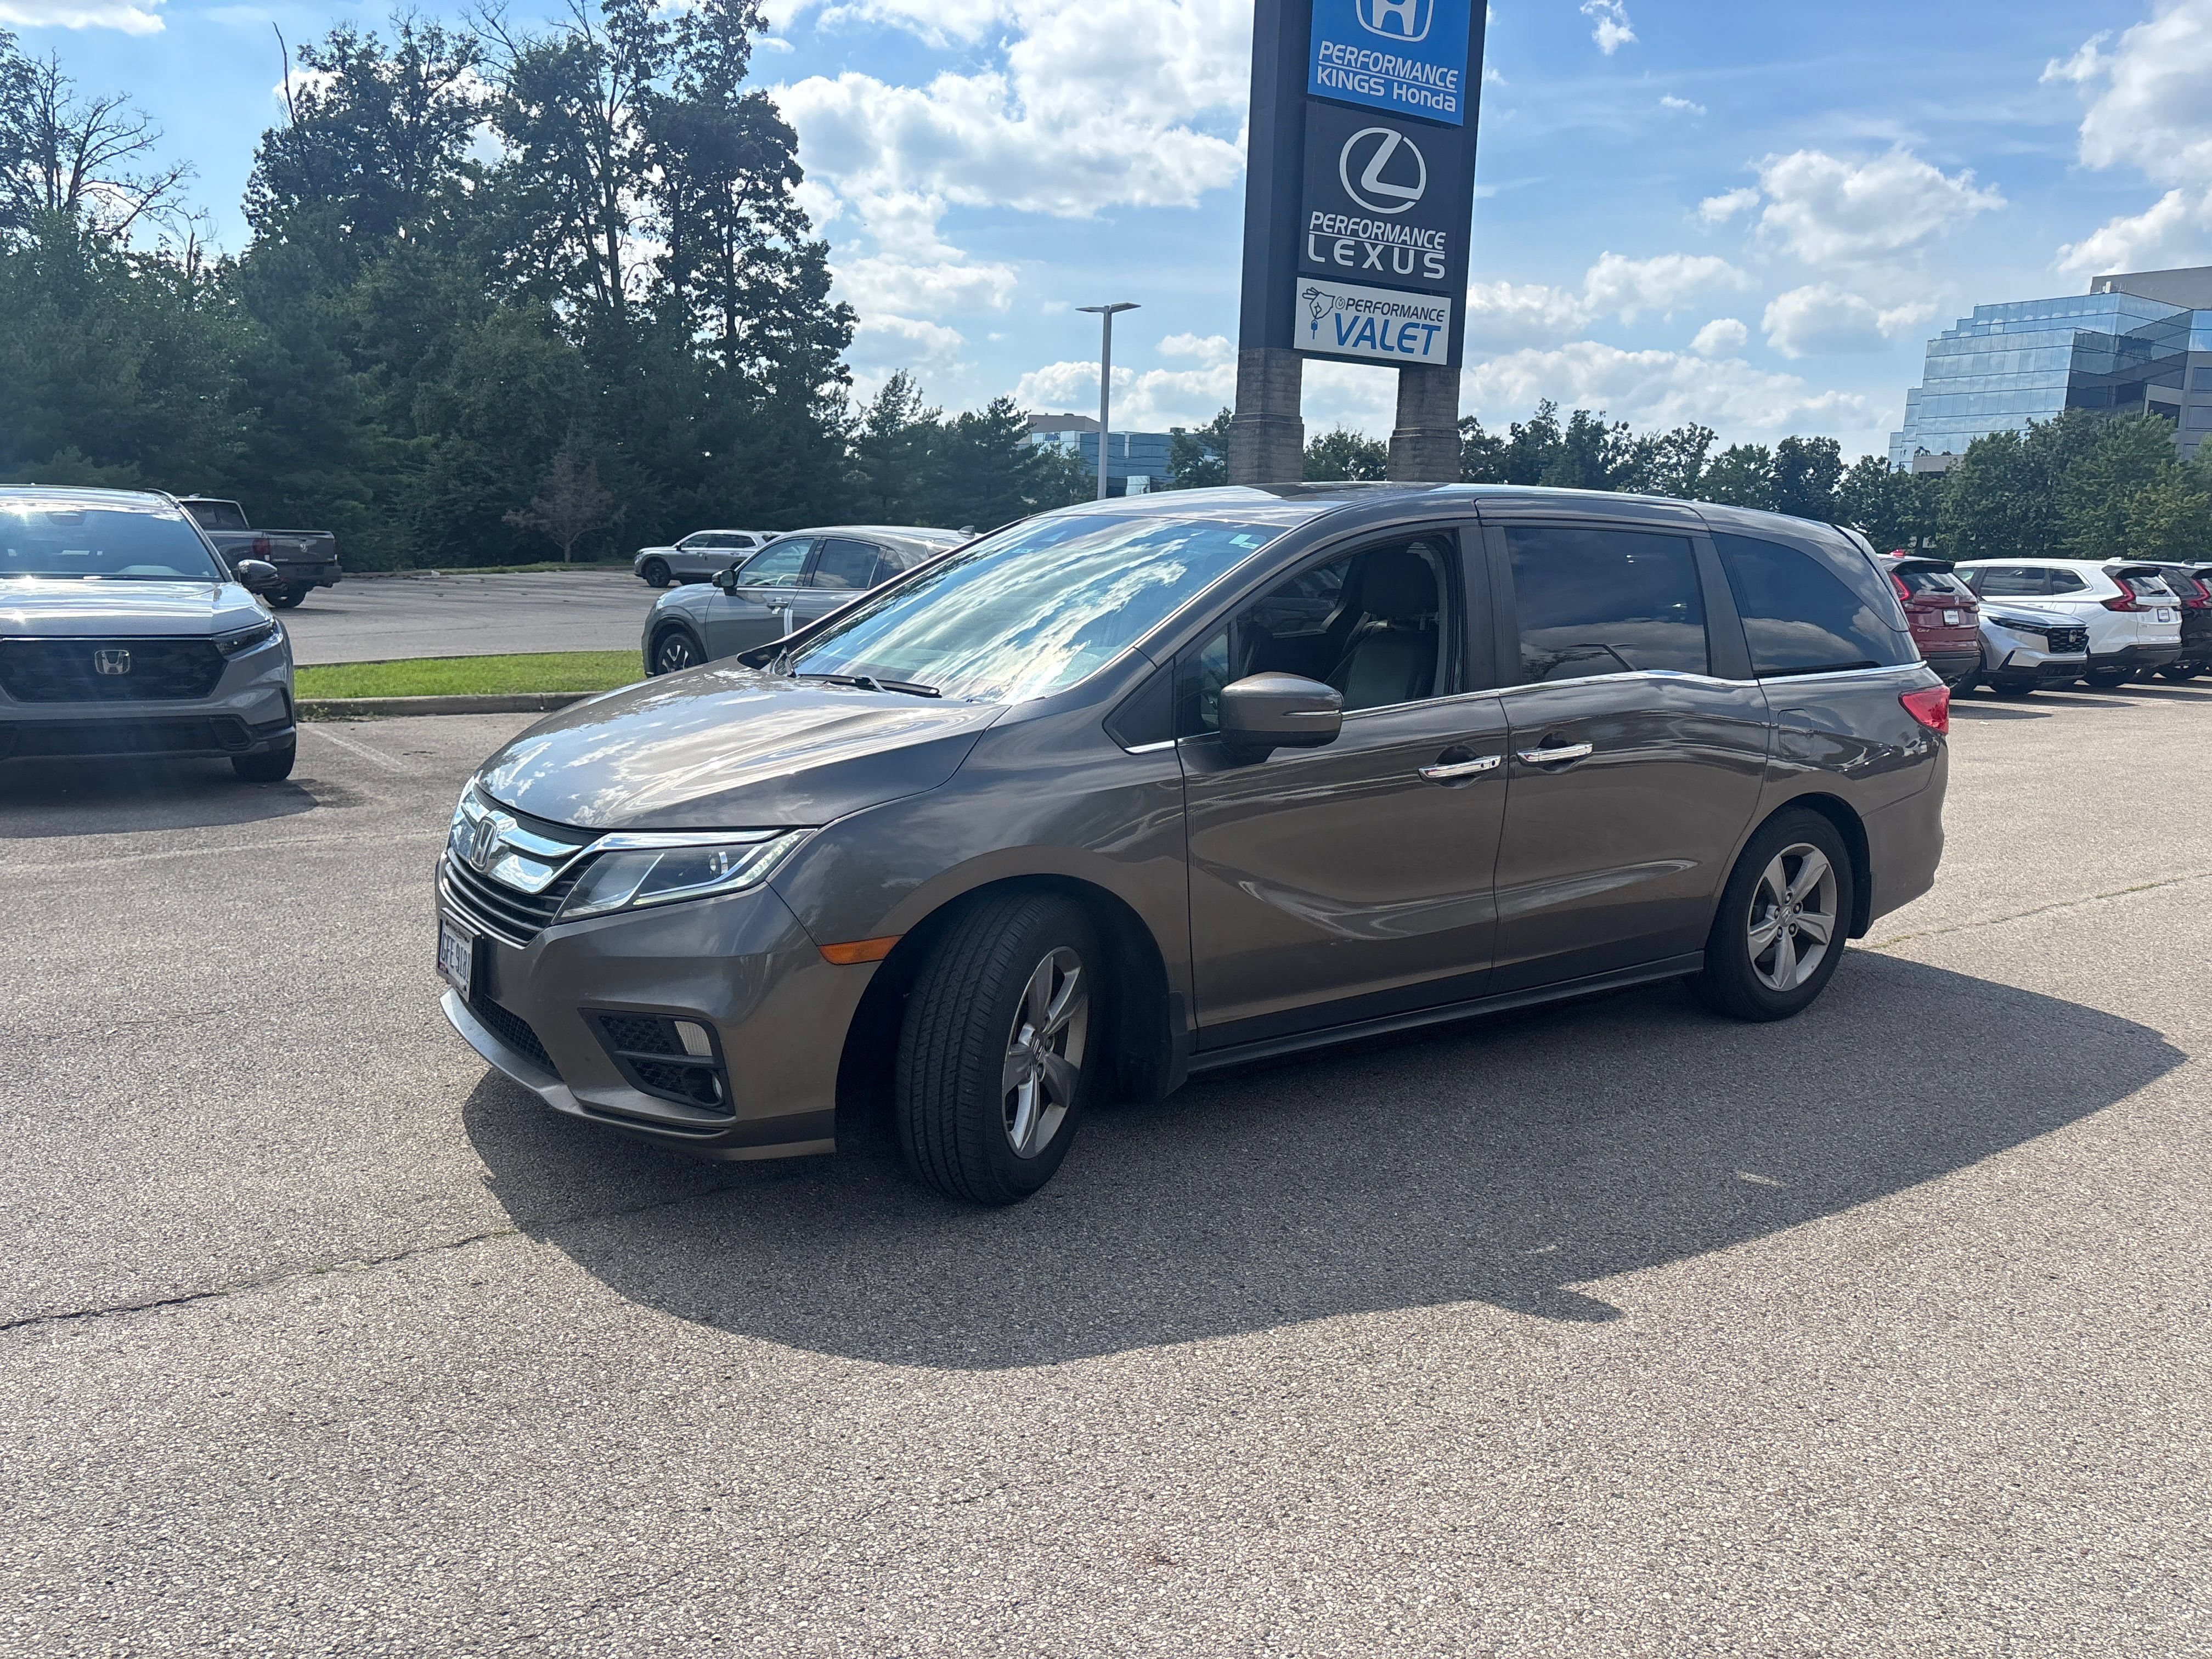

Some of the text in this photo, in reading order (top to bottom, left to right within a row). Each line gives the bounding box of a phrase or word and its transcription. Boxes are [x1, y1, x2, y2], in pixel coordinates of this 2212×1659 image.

[1319, 41, 1459, 89] PERFORMANCE
[1317, 66, 1456, 112] KINGS Honda
[1309, 211, 1446, 250] PERFORMANCE
[1308, 234, 1446, 279] LEXUS
[1345, 297, 1446, 323] PERFORMANCE
[1334, 313, 1442, 356] VALET
